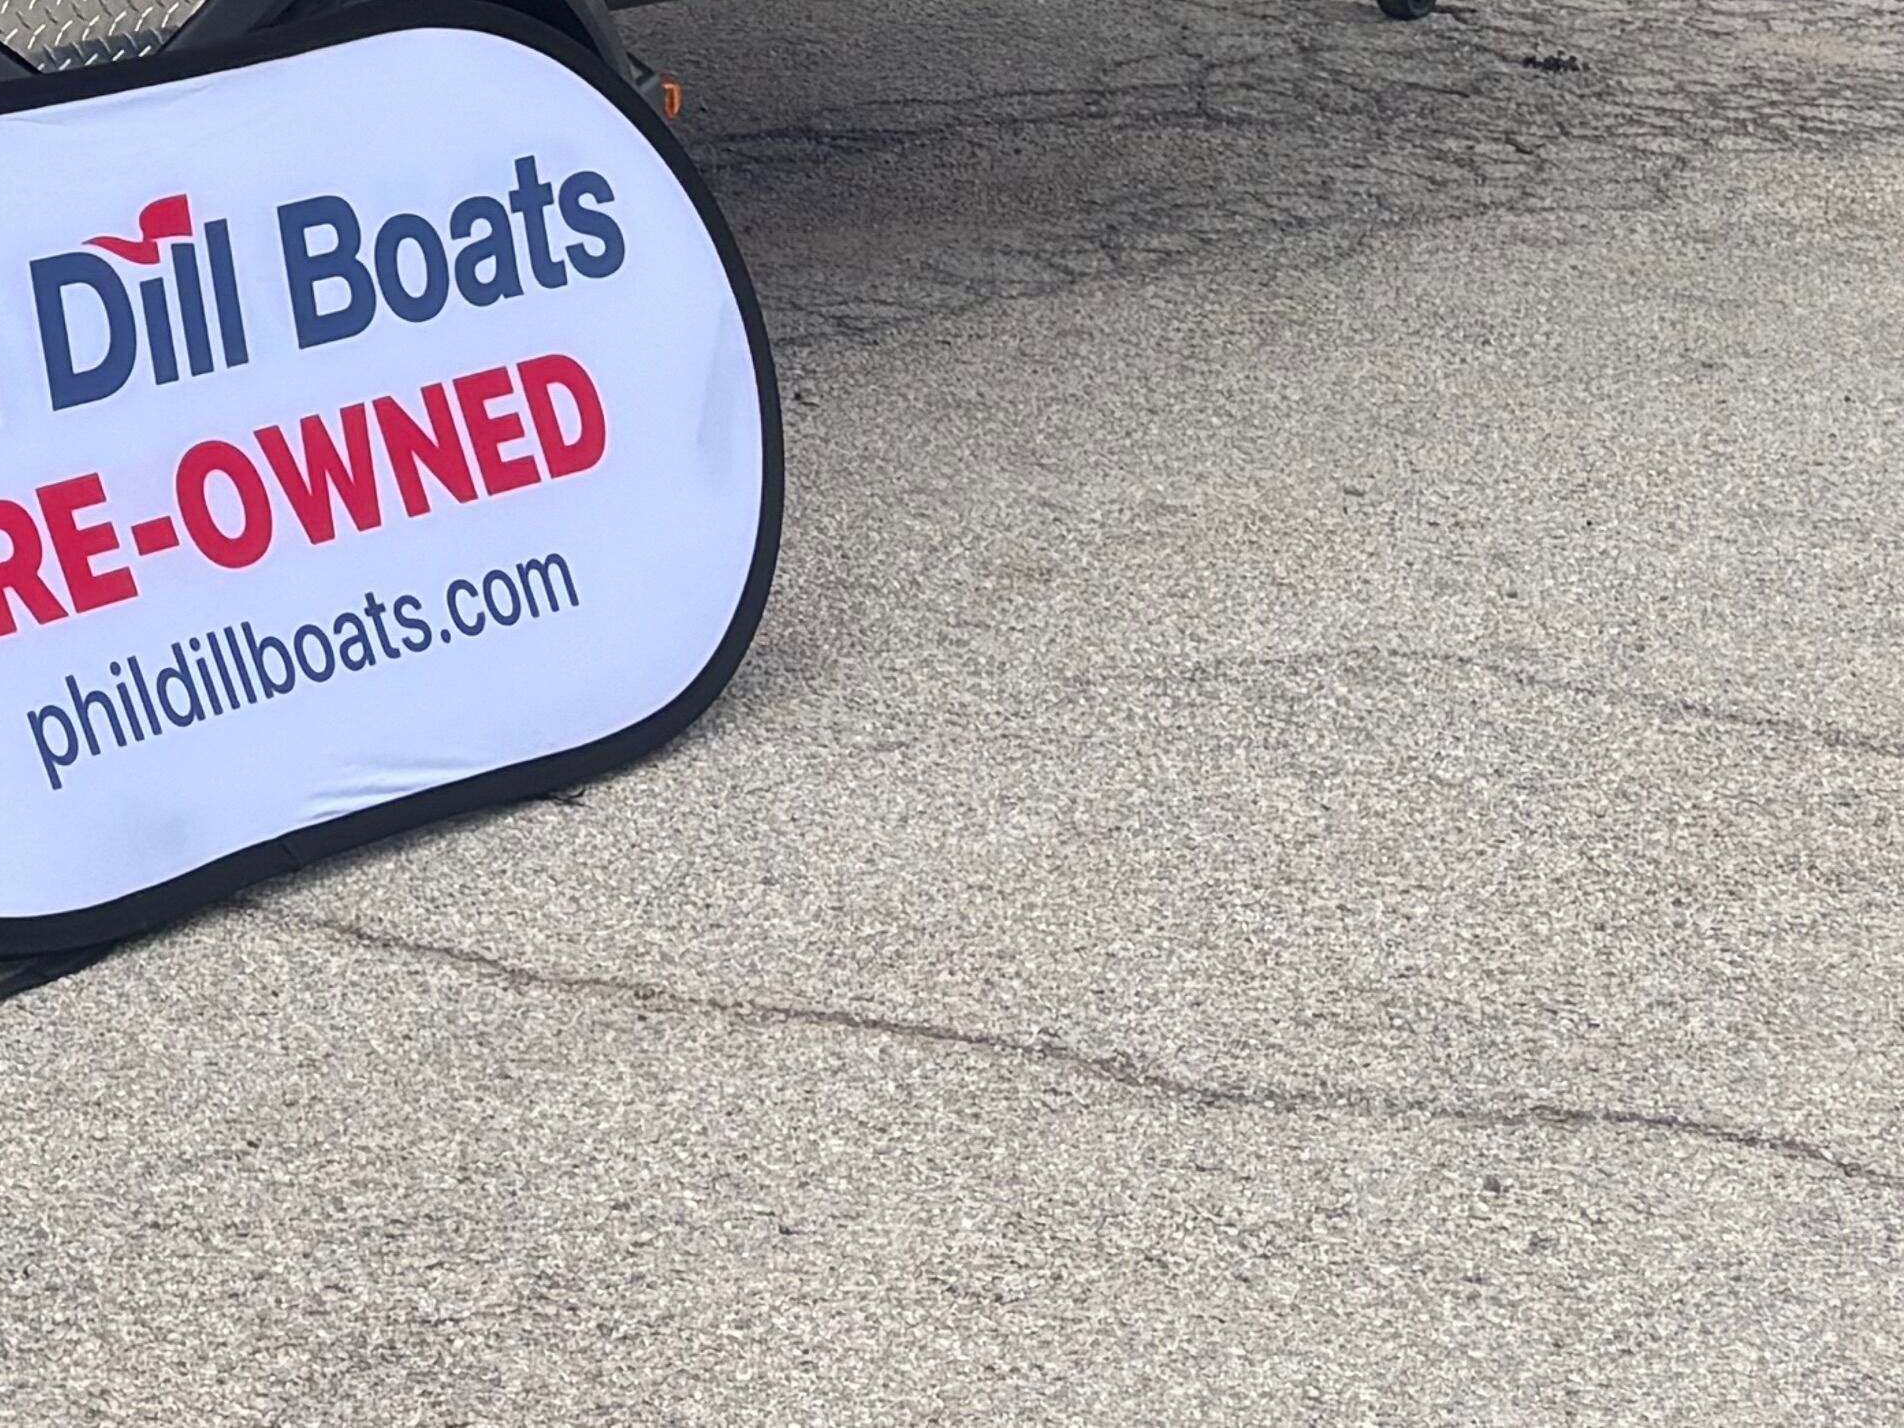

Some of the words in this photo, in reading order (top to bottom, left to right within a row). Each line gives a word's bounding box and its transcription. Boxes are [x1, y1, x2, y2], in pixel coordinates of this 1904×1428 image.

[29, 194, 250, 410] Dill
[276, 155, 626, 350] Boats
[26, 552, 581, 791] phildillboats.com
